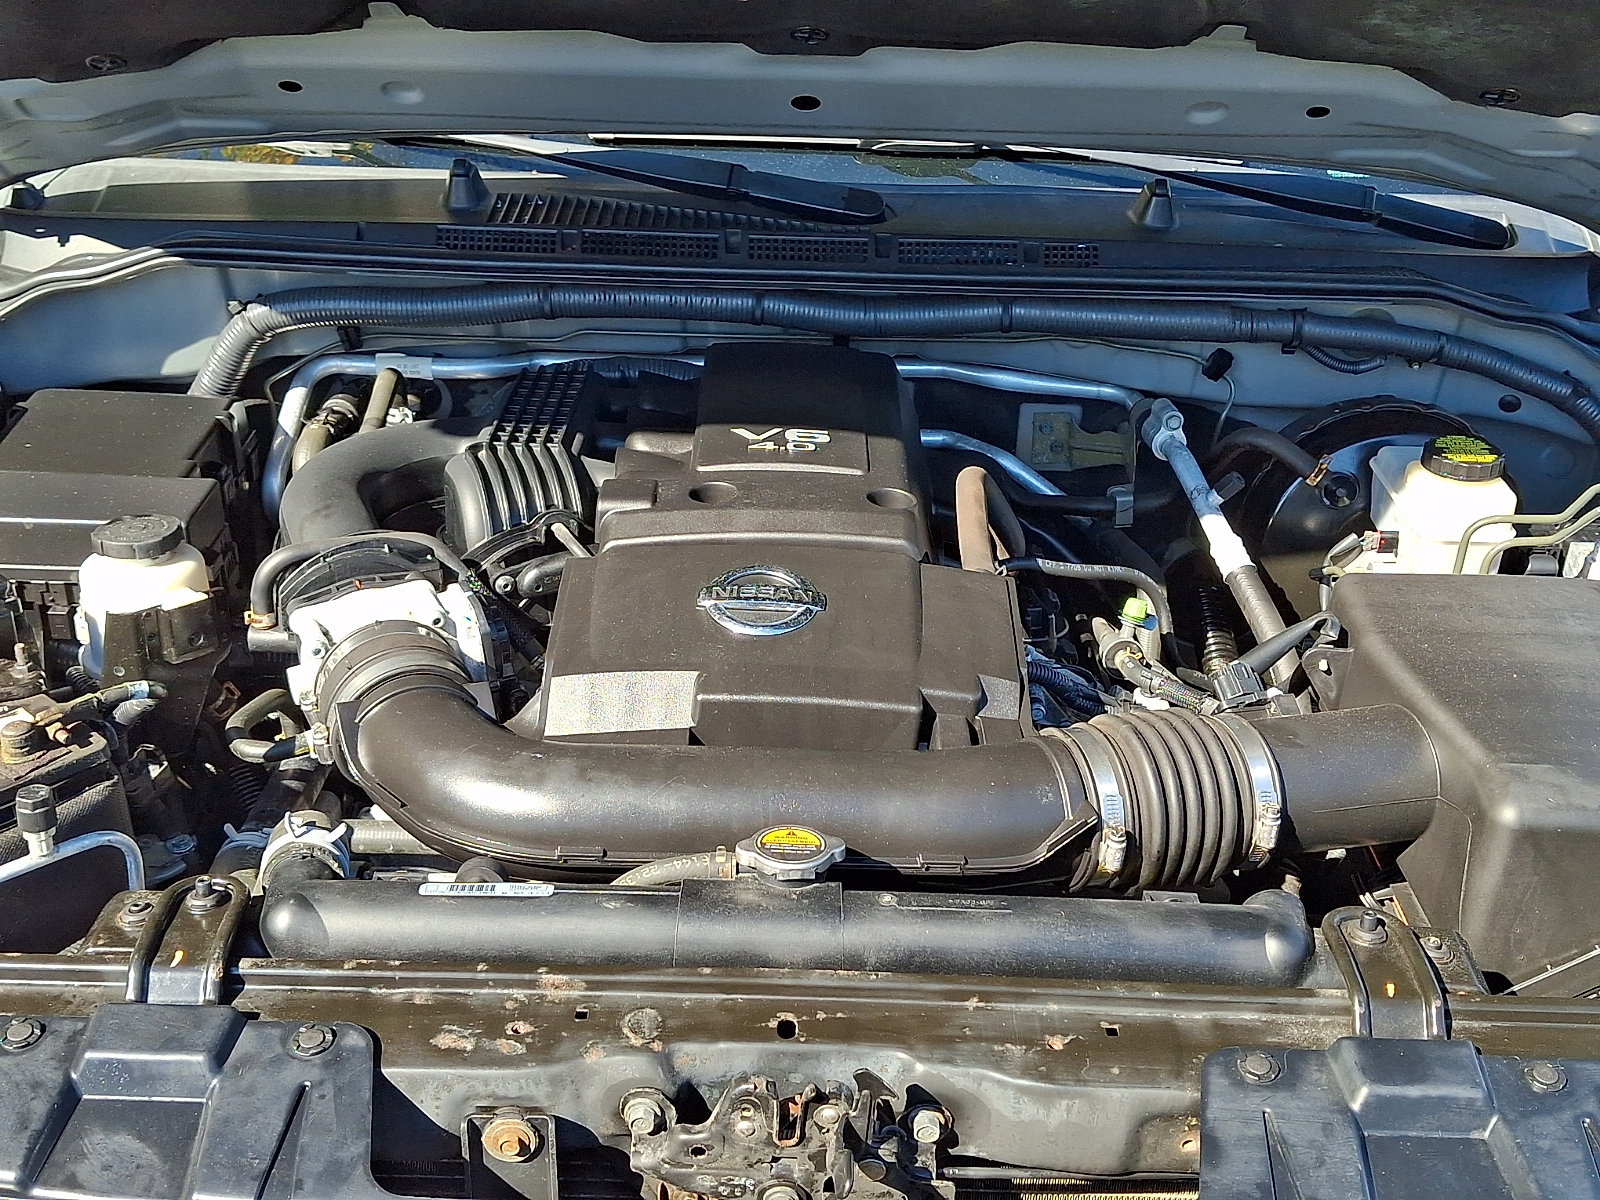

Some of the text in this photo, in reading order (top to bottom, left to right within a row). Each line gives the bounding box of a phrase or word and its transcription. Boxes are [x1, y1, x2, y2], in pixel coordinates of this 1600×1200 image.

[730, 427, 831, 443] V6
[747, 441, 817, 452] 4.0
[711, 585, 814, 603] NISSAN
